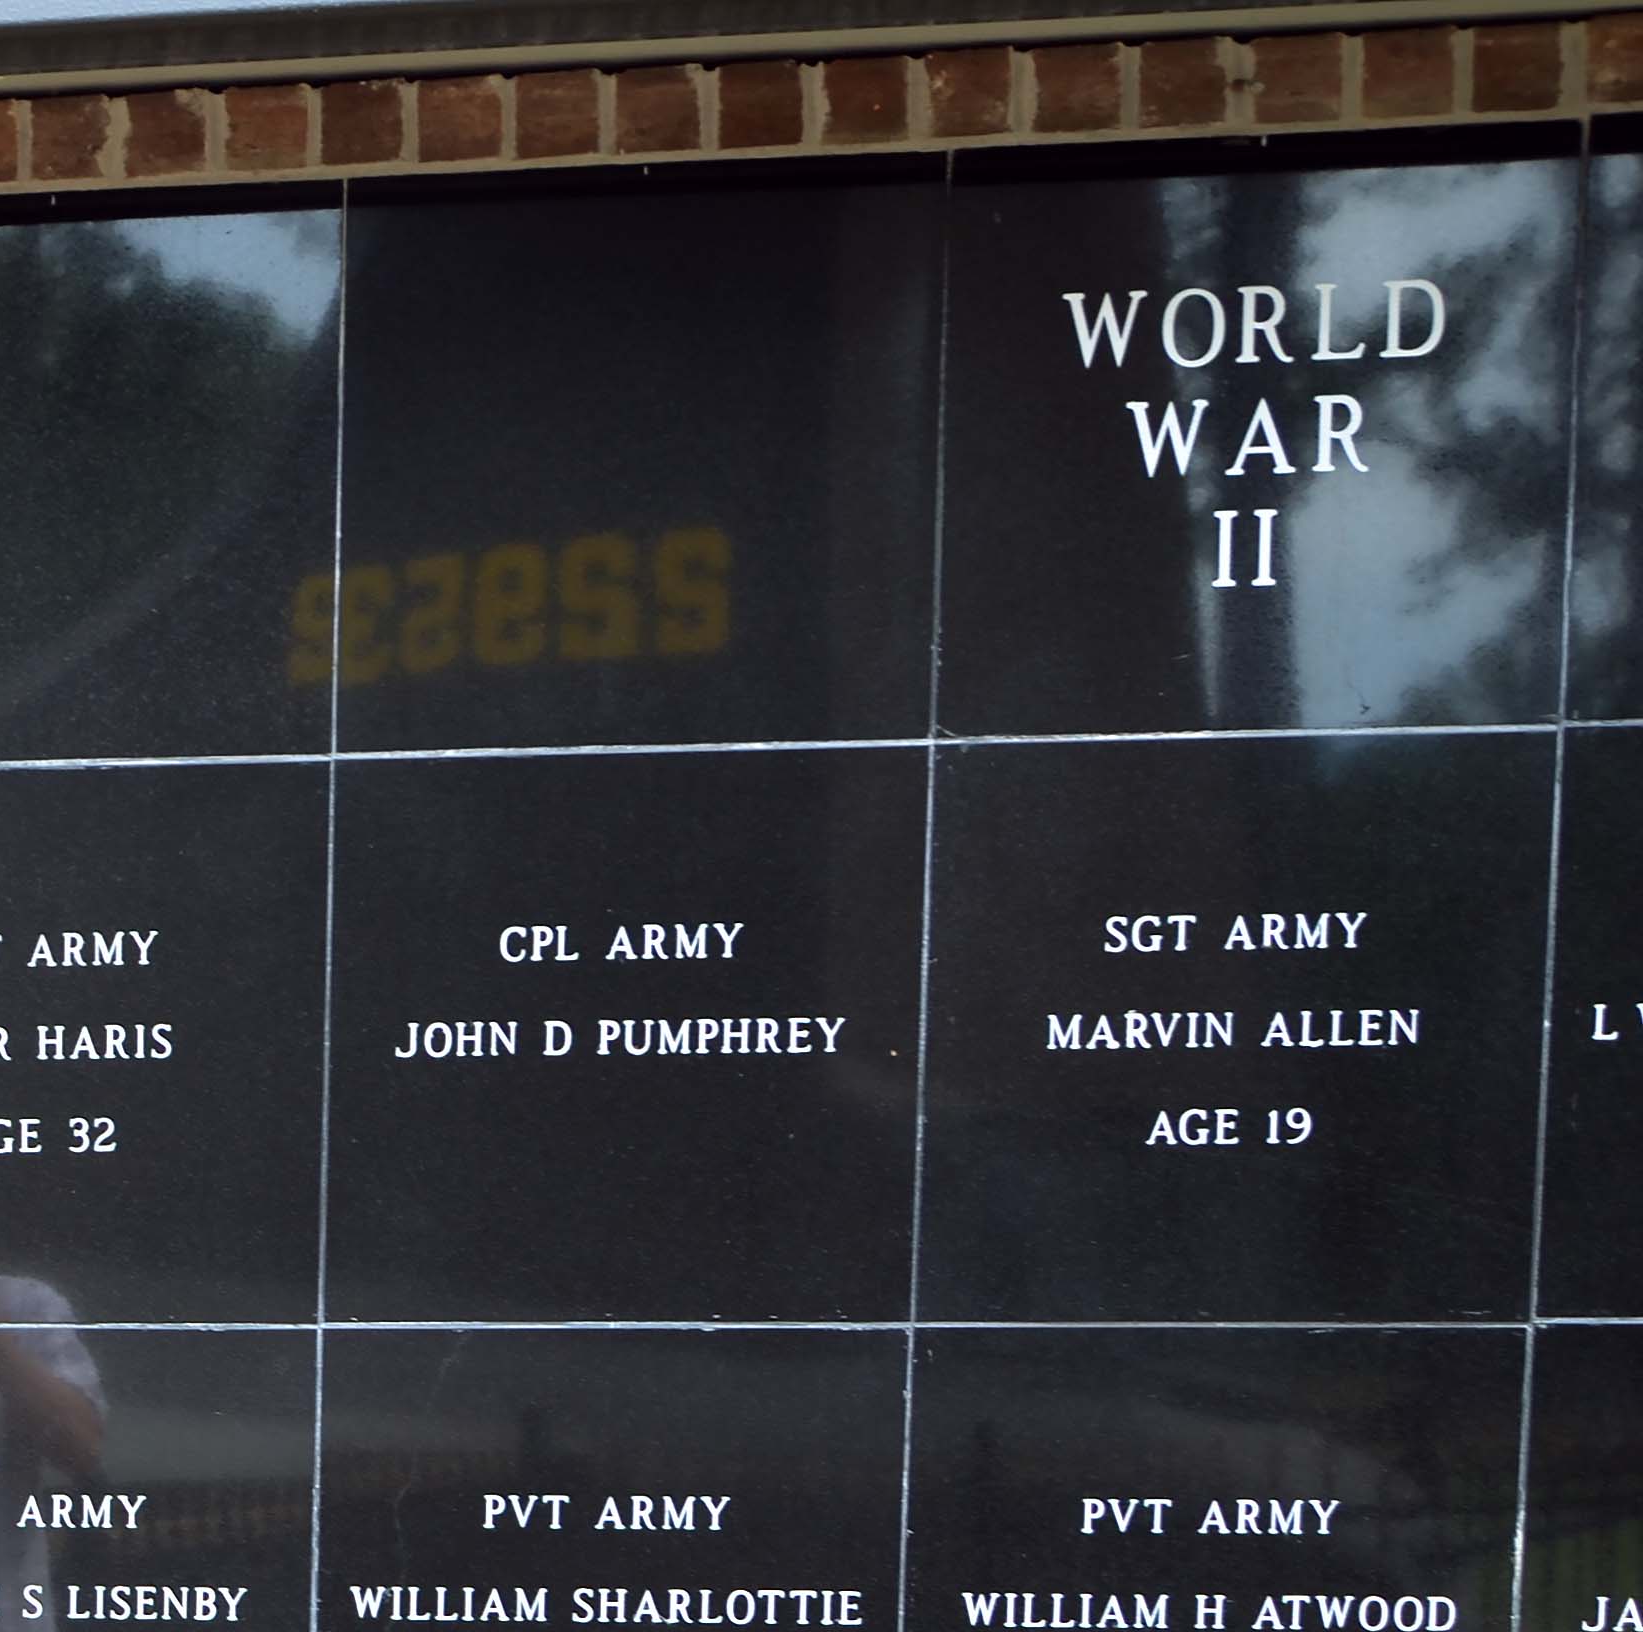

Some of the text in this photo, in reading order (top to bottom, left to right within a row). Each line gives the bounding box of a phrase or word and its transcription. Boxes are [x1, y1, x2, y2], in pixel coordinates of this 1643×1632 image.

[1062, 279, 1444, 369] WORLD
[1125, 393, 1370, 478] WAR
[1211, 508, 1279, 588] II
[26, 929, 160, 969] ARMY
[498, 921, 745, 964] CPL ARMY
[1103, 911, 1368, 954] SGT ARMY
[36, 1022, 173, 1061] HARIS
[394, 1016, 847, 1059] JOHN D PUMPHREY
[1045, 1008, 1420, 1051] MARVIN ALLEN
[1591, 1002, 1619, 1042] L
[67, 1116, 118, 1154] 32
[1144, 1106, 1313, 1147] AGE 19
[15, 1493, 148, 1530] ARMY
[481, 1493, 732, 1532] PVT ARMY
[1079, 1497, 1341, 1536] PVT ARMY
[21, 1583, 44, 1620] S
[65, 1584, 249, 1623] LISENBY
[348, 1584, 863, 1627] WILLIAM SHARLOTTIE
[960, 1591, 1457, 1632] WILLIAM H ATWOOD
